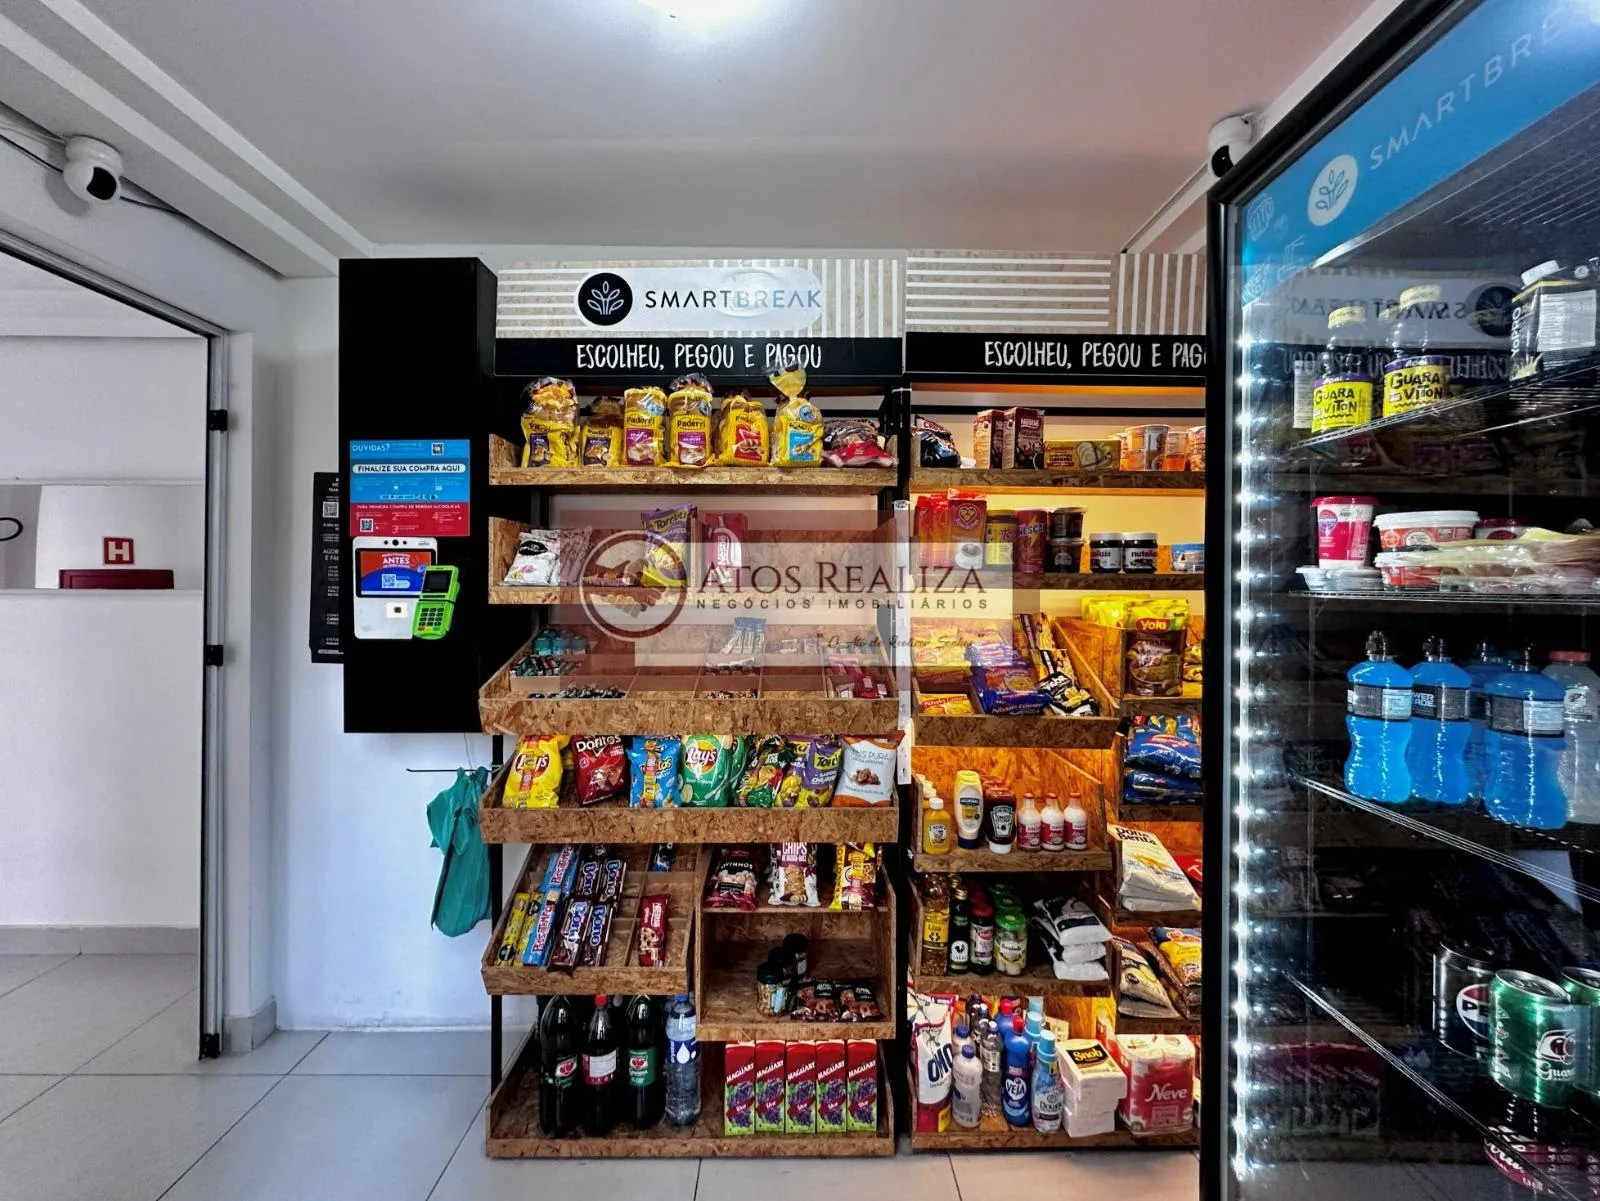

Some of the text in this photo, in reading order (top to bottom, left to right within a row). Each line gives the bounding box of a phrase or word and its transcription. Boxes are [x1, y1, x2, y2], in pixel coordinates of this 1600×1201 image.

[645, 289, 822, 309] SMARTBREAK
[576, 343, 822, 371] ESCOLHEU, PEGOU E PAGOU
[984, 340, 1206, 370] ESCOLHEU, PEGOU E PAG
[1391, 372, 1440, 390] GUARA
[1404, 386, 1443, 401] VITON
[441, 465, 460, 473] AQUI
[108, 541, 130, 561] H
[383, 557, 410, 565] ANTES
[1140, 619, 1167, 631] Yoki
[685, 746, 717, 766] Lay's
[782, 842, 808, 855] CHIPS
[589, 903, 608, 947] Bono
[927, 1042, 952, 1083] OMO
[1072, 1048, 1103, 1061] Snob
[756, 1060, 784, 1078] MAGUARY
[787, 1061, 816, 1081] MAGUARY
[817, 1060, 845, 1079] MAGUARY
[848, 1060, 876, 1077] MAGUARY
[1006, 1081, 1026, 1095] VEJA
[1145, 1083, 1188, 1103] Neve
